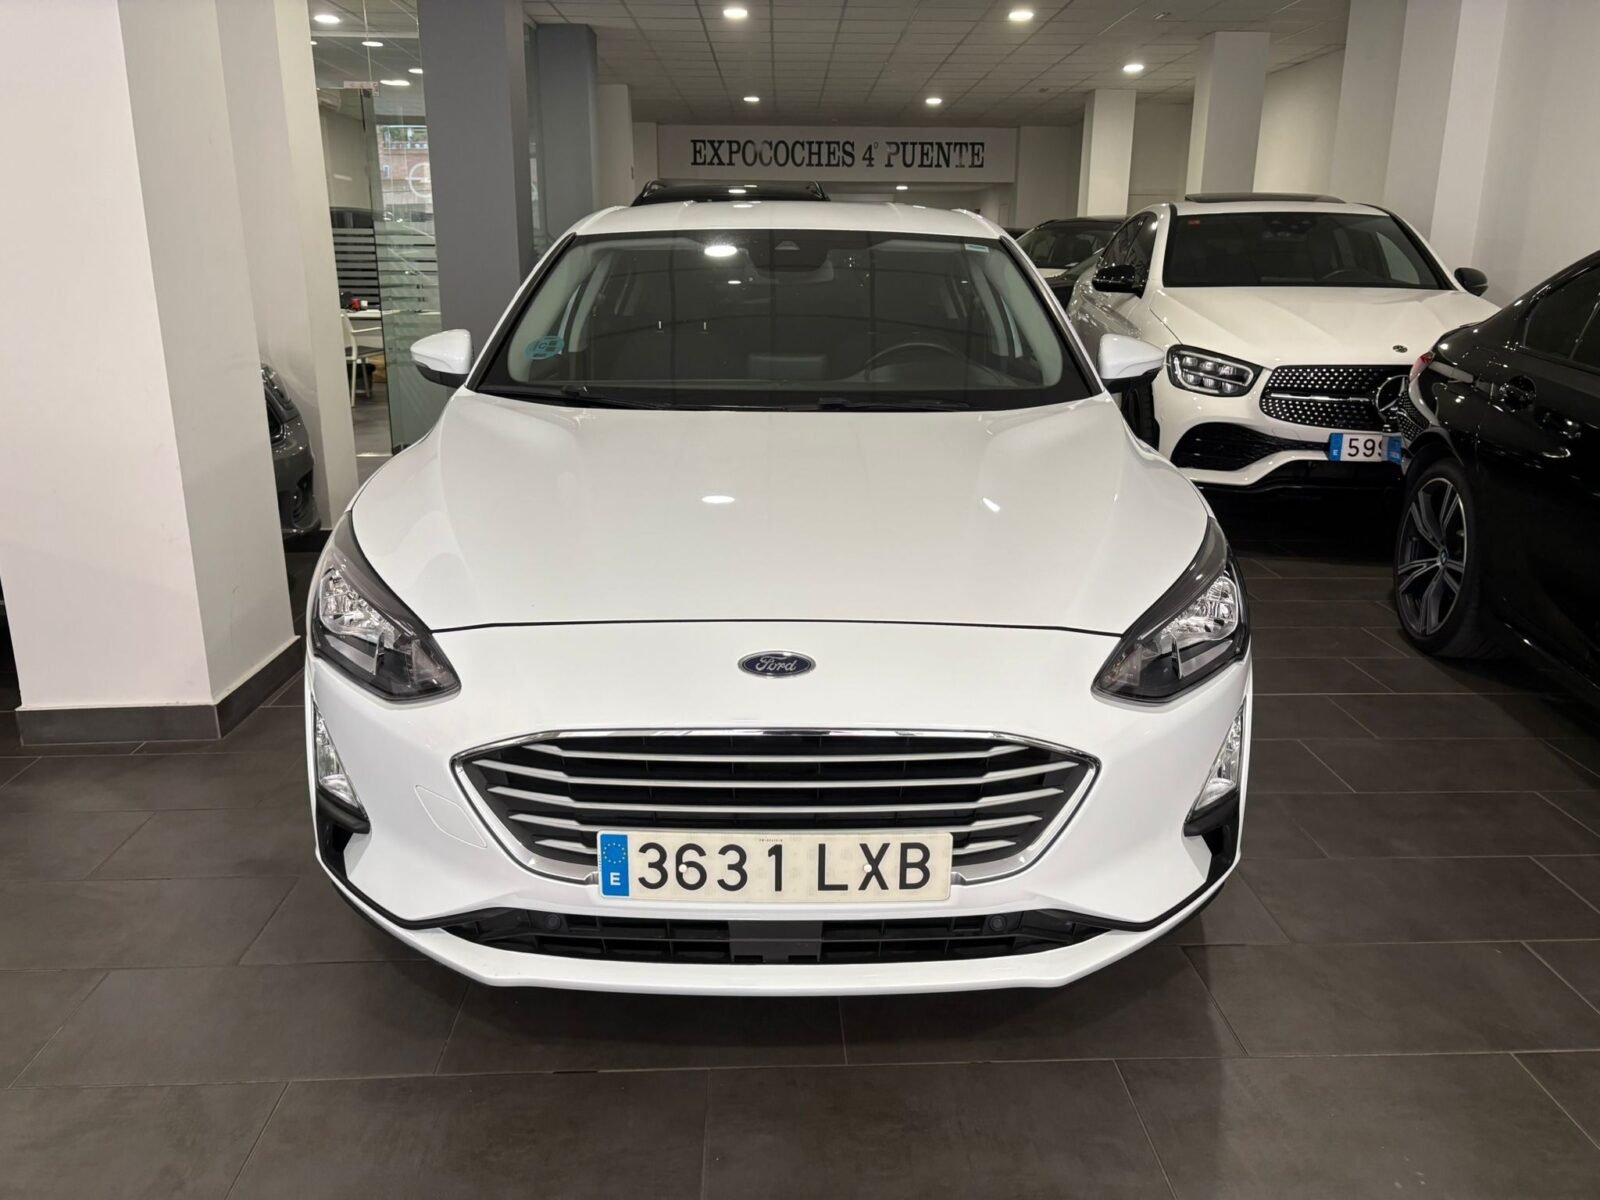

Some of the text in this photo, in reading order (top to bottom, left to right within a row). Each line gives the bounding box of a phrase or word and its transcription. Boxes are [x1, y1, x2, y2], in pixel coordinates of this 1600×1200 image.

[690, 139, 855, 168] EXPOCOCHES
[885, 141, 985, 168] PUENTE
[755, 655, 797, 671] Ford
[638, 842, 931, 892] 3631 LXB
[610, 872, 621, 886] E
